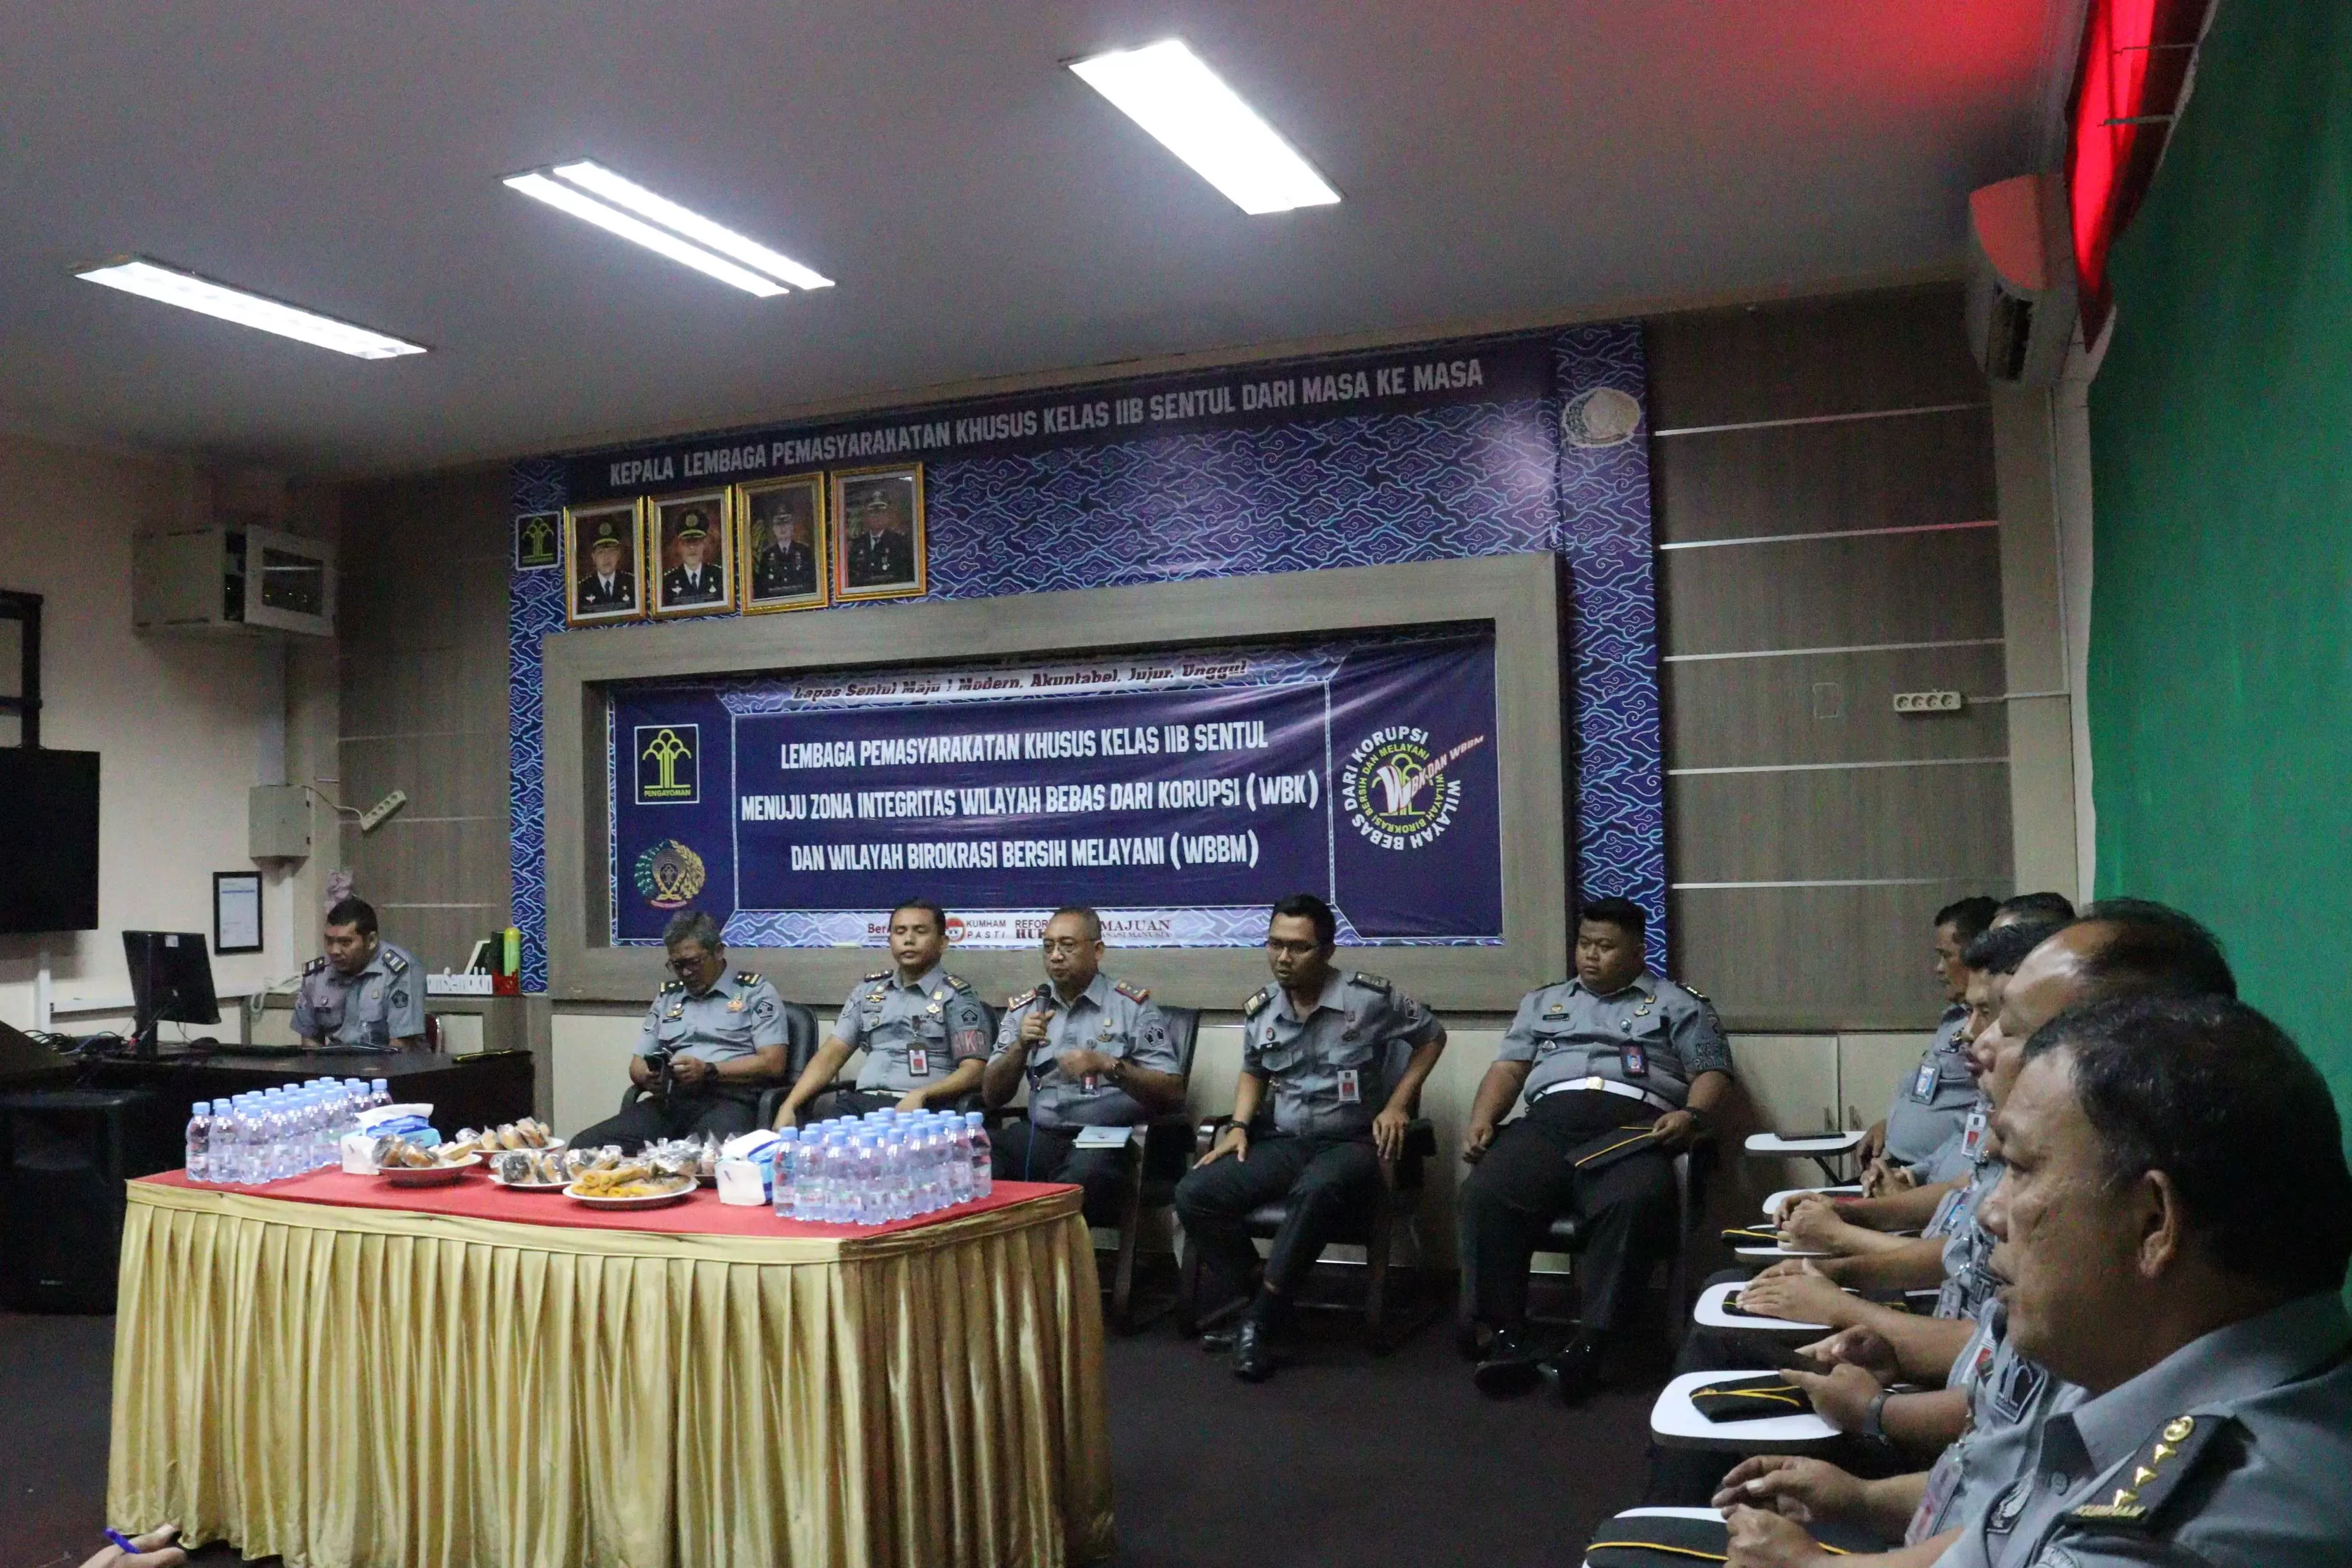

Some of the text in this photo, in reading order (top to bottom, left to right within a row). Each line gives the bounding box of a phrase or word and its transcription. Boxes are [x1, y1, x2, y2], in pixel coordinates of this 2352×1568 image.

[611, 360, 1483, 486] KEPALA LEMBAGA PEMASYARAKATAN KHUSUS KELAS IIB SENTUL DARI MASA KE MASA
[793, 687, 841, 703] Lapas
[901, 680, 940, 695] Maju
[782, 721, 1269, 769] LEMBAGA PEMASYARAKATAN KHUSUS KELAS IIB SENTUL
[1427, 754, 1447, 780] DAN
[742, 770, 1318, 820] MENUJU ZONA INTEGRITAS WILAYAH BEBAS DARI KORUPSI (WBK)
[1342, 726, 1461, 850] WILAYAH BEBAS DARI KORUPSI
[1358, 743, 1445, 833] WILAYAH BIROKRASI BERSIH DAN MELAYANI
[791, 829, 1259, 870] DAN WILAYAH BIROKRASI BERSIH MELAYANI (WBBM)
[966, 919, 1007, 928] KUMHAM
[967, 931, 1006, 939] PASTI
[1015, 919, 1048, 929] REFOR
[1100, 920, 1171, 932] MAJUAN
